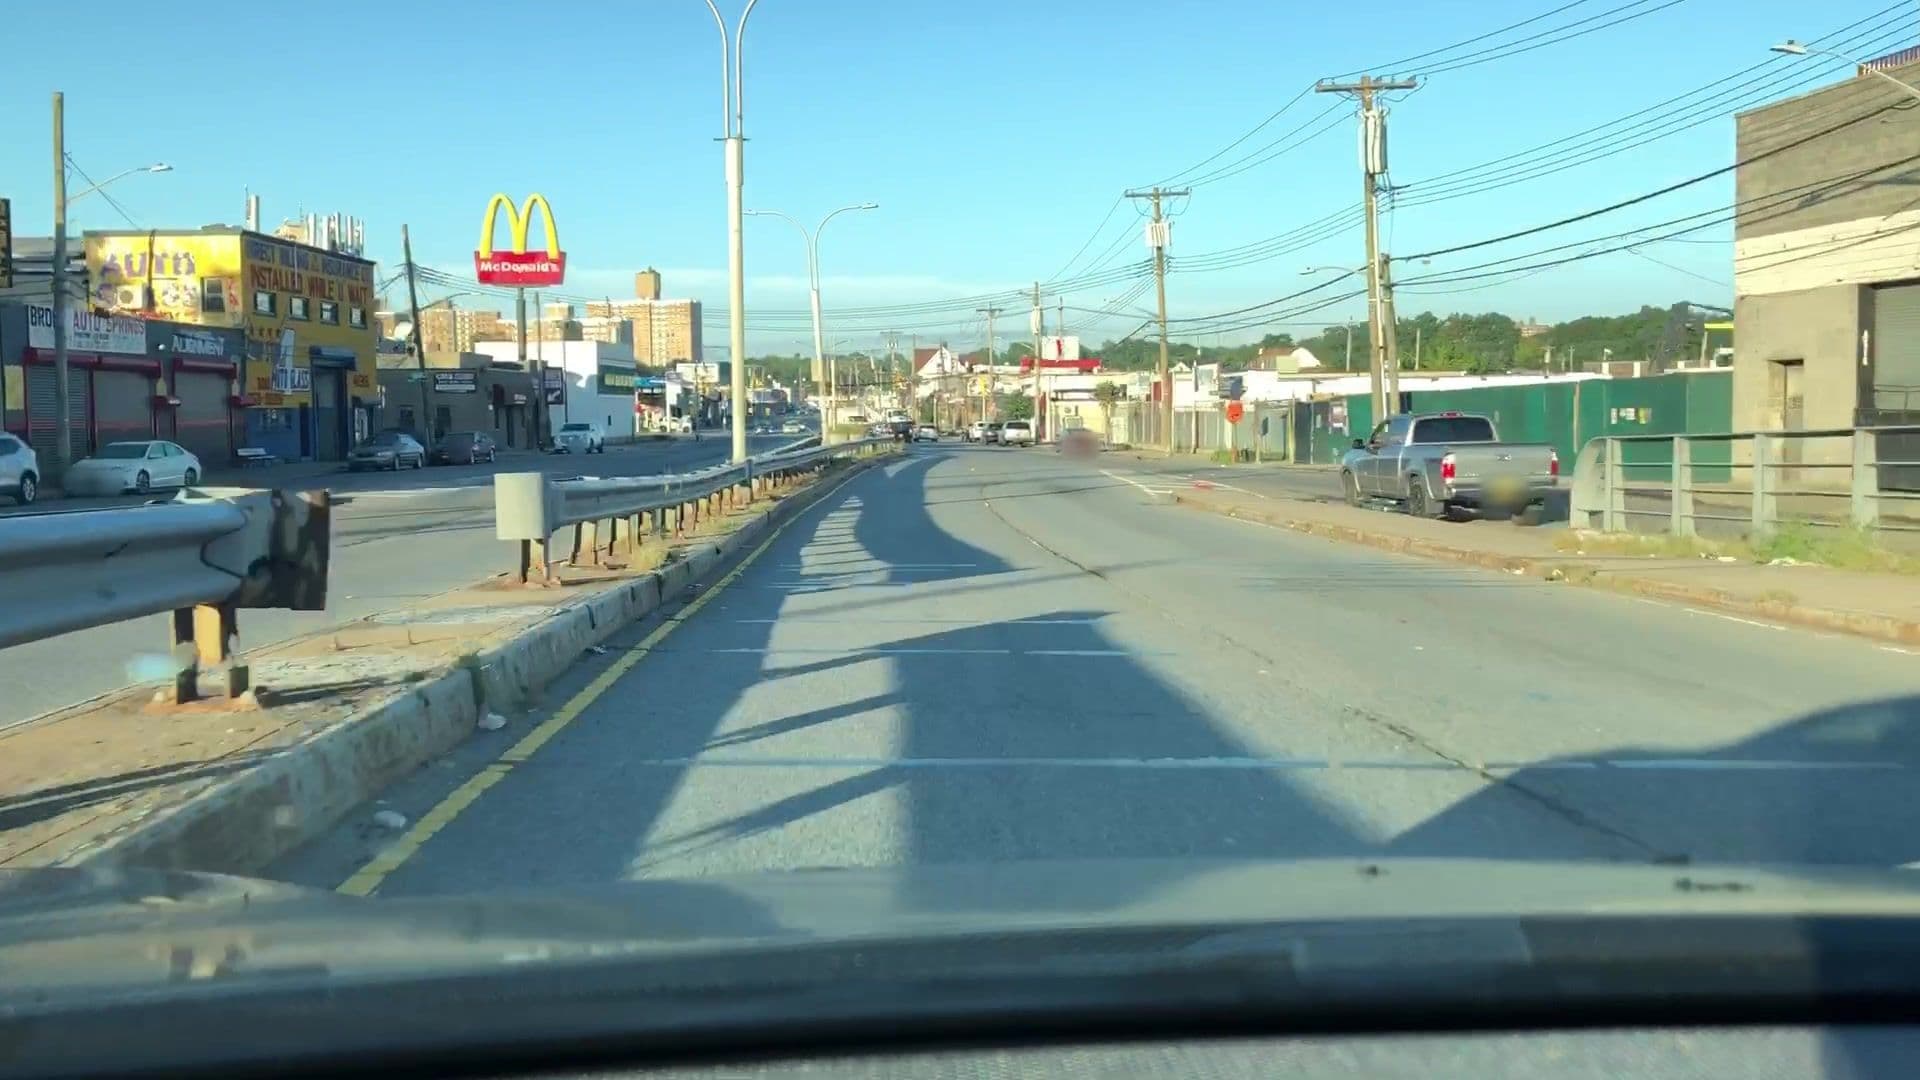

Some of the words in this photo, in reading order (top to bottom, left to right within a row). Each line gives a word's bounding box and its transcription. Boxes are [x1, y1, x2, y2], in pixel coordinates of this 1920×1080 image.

[480, 261, 560, 273] McDonald's
[73, 311, 101, 332] AUTO
[104, 316, 145, 335] SPRINGS
